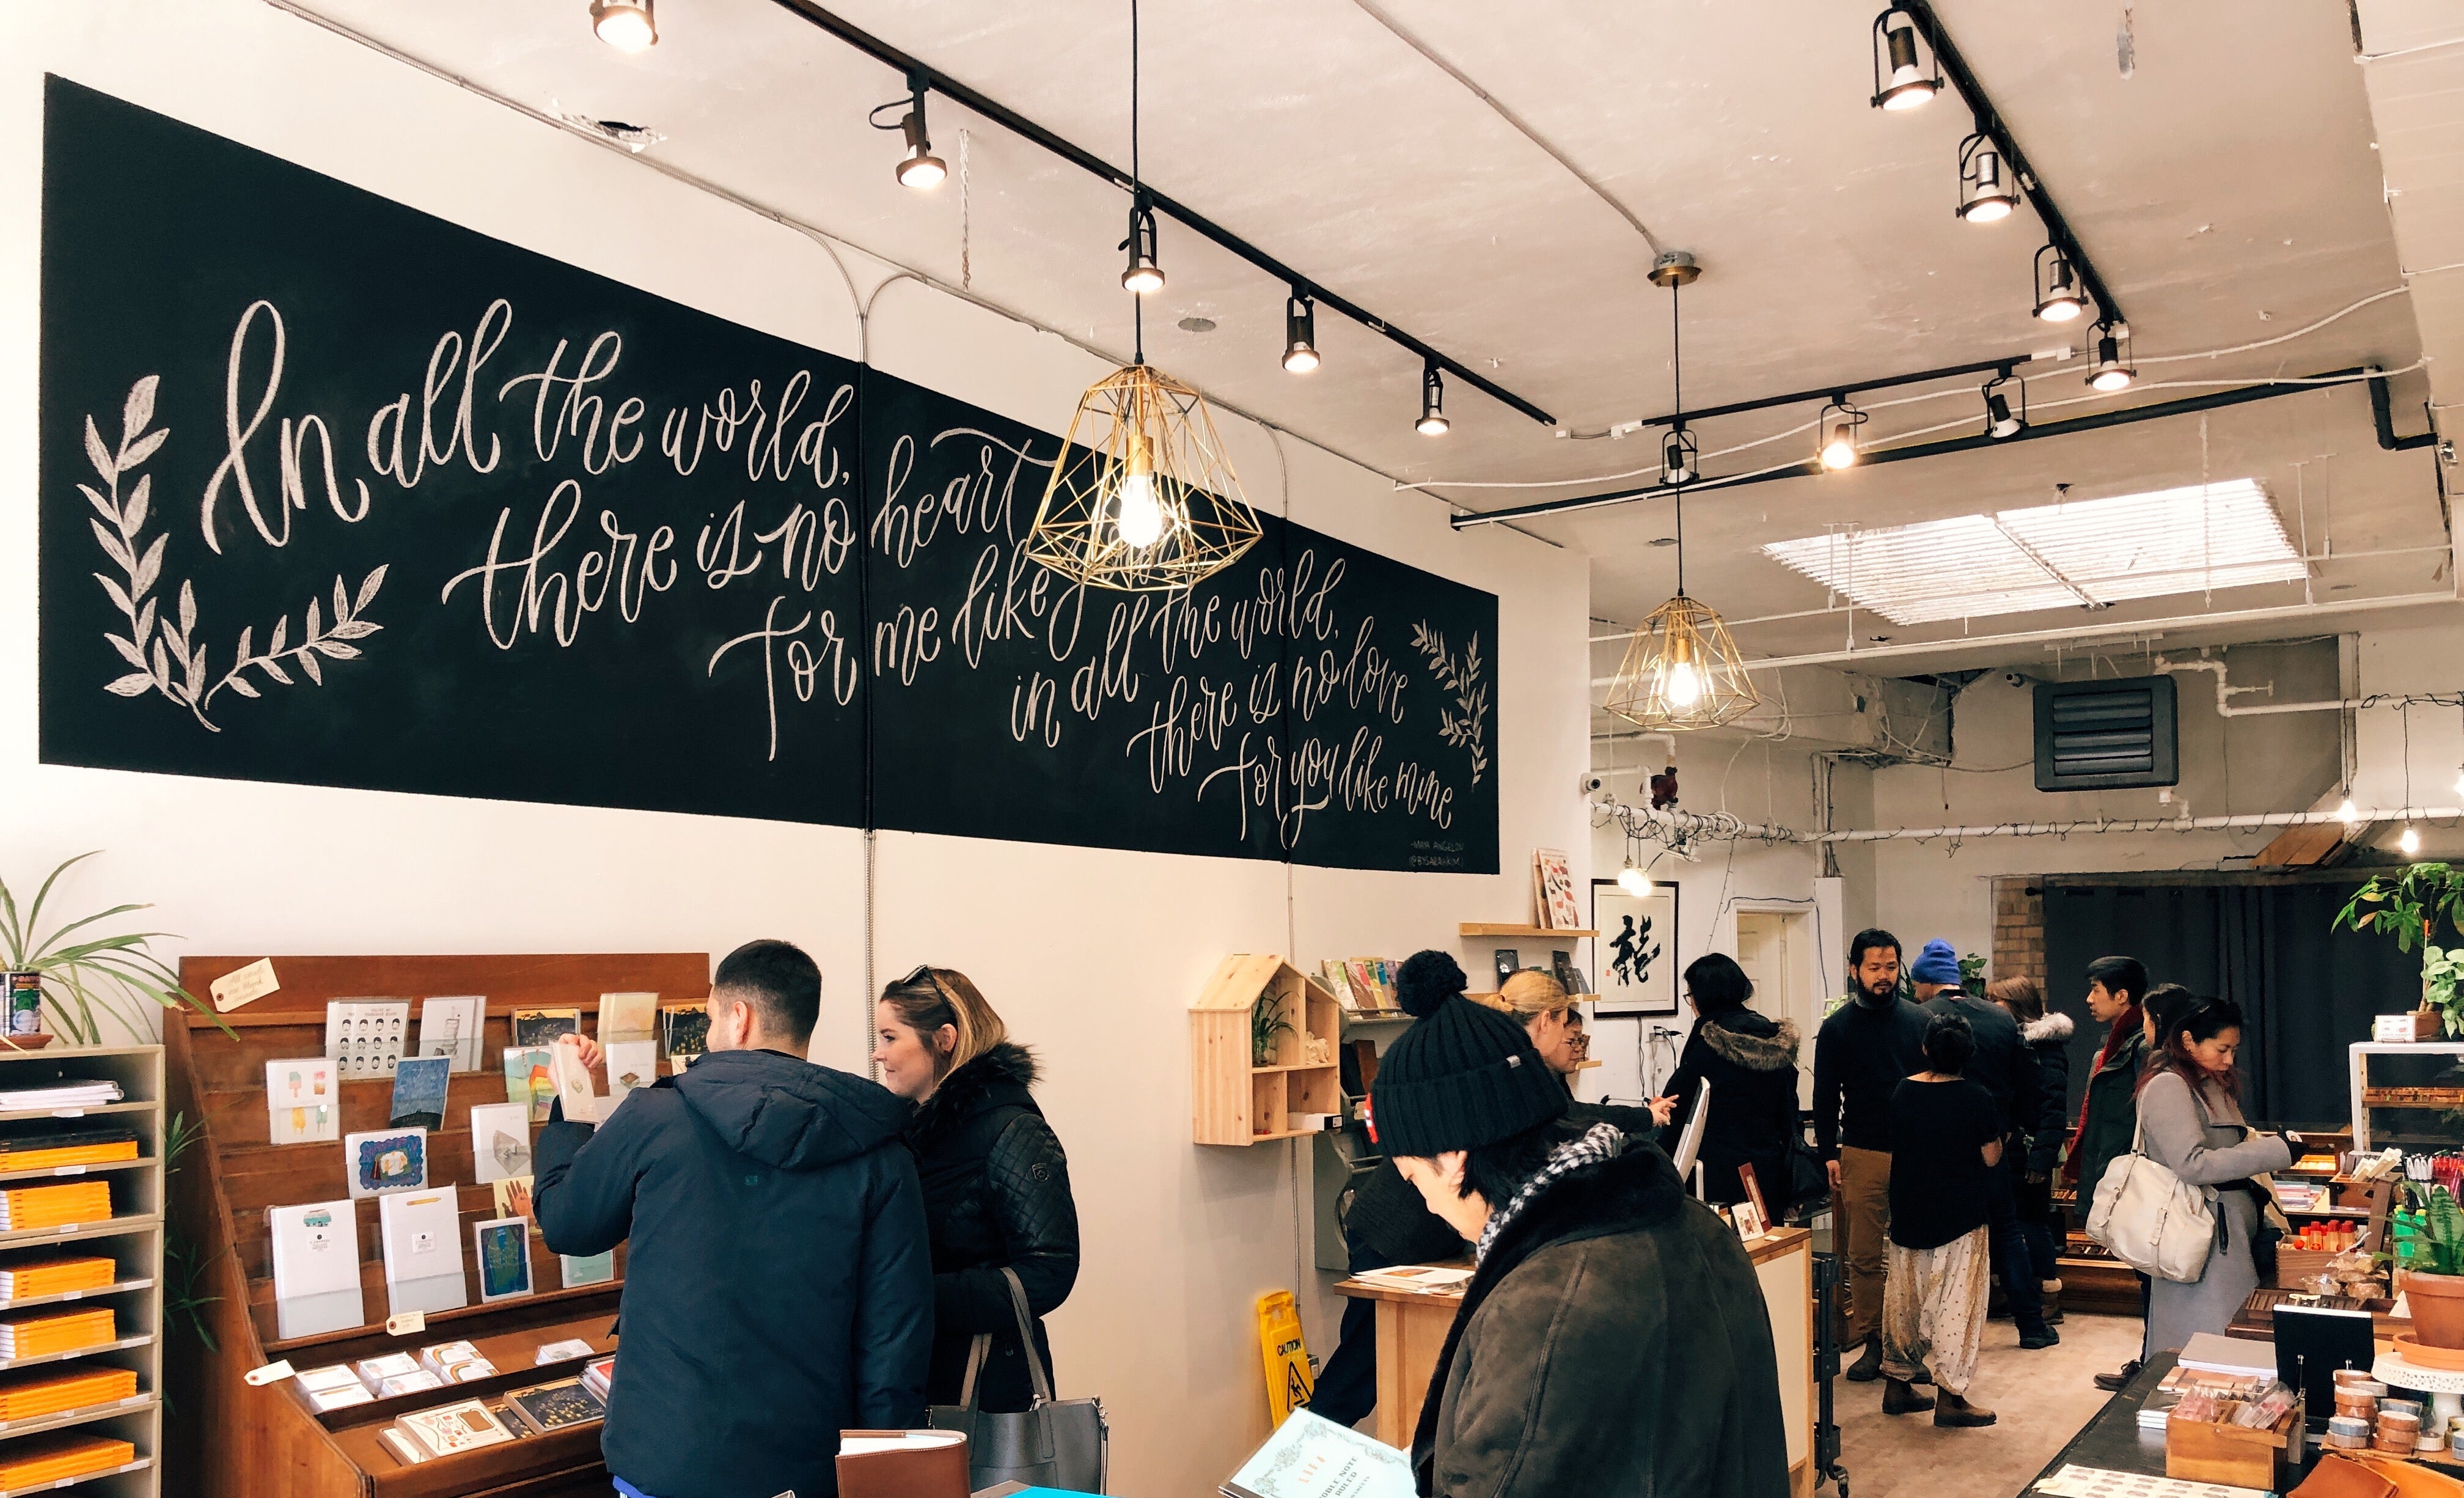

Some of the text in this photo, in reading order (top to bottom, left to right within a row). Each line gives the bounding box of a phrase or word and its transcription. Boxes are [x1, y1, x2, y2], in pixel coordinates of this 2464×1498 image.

[200, 298, 853, 555] In all the world,
[441, 427, 1059, 650] there is no heart
[708, 595, 857, 762] for
[875, 606, 941, 686] me
[952, 538, 1050, 669] like
[1011, 546, 1346, 748] in all the world,
[1126, 615, 1408, 794] there is no love
[1197, 725, 1453, 850] for you like mine
[1277, 1337, 1301, 1356] CAUTION
[1319, 1456, 1359, 1498] OBLE NOTE
[1335, 1471, 1357, 1496] RULED
